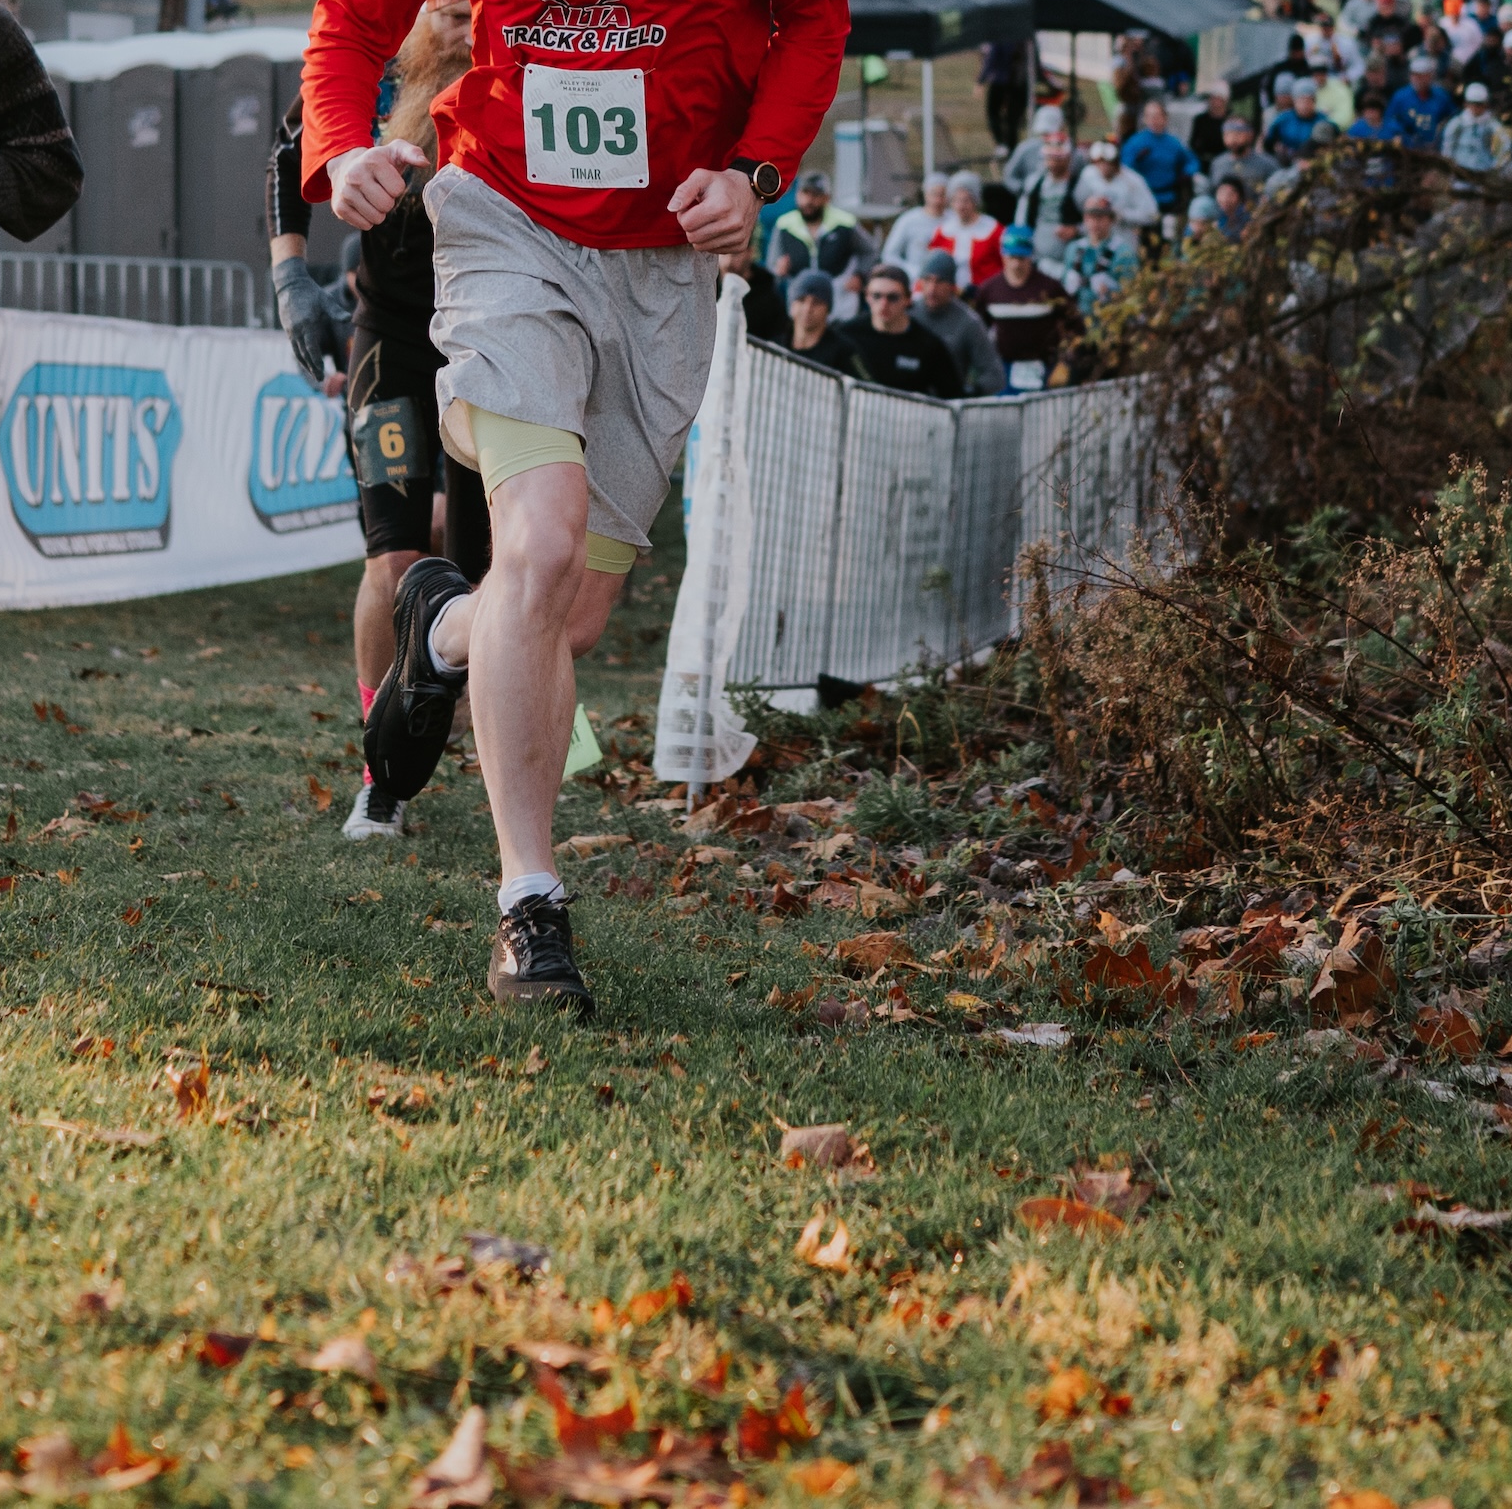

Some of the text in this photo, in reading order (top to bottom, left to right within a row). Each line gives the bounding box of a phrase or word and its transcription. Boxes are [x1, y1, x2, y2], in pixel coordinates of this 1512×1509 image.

[536, 5, 630, 29] ALTA
[502, 24, 666, 53] TRACK & FIELD
[531, 103, 638, 156] 103
[570, 167, 601, 181] TINAR
[10, 394, 172, 508] UNITS
[378, 422, 405, 459] 6
